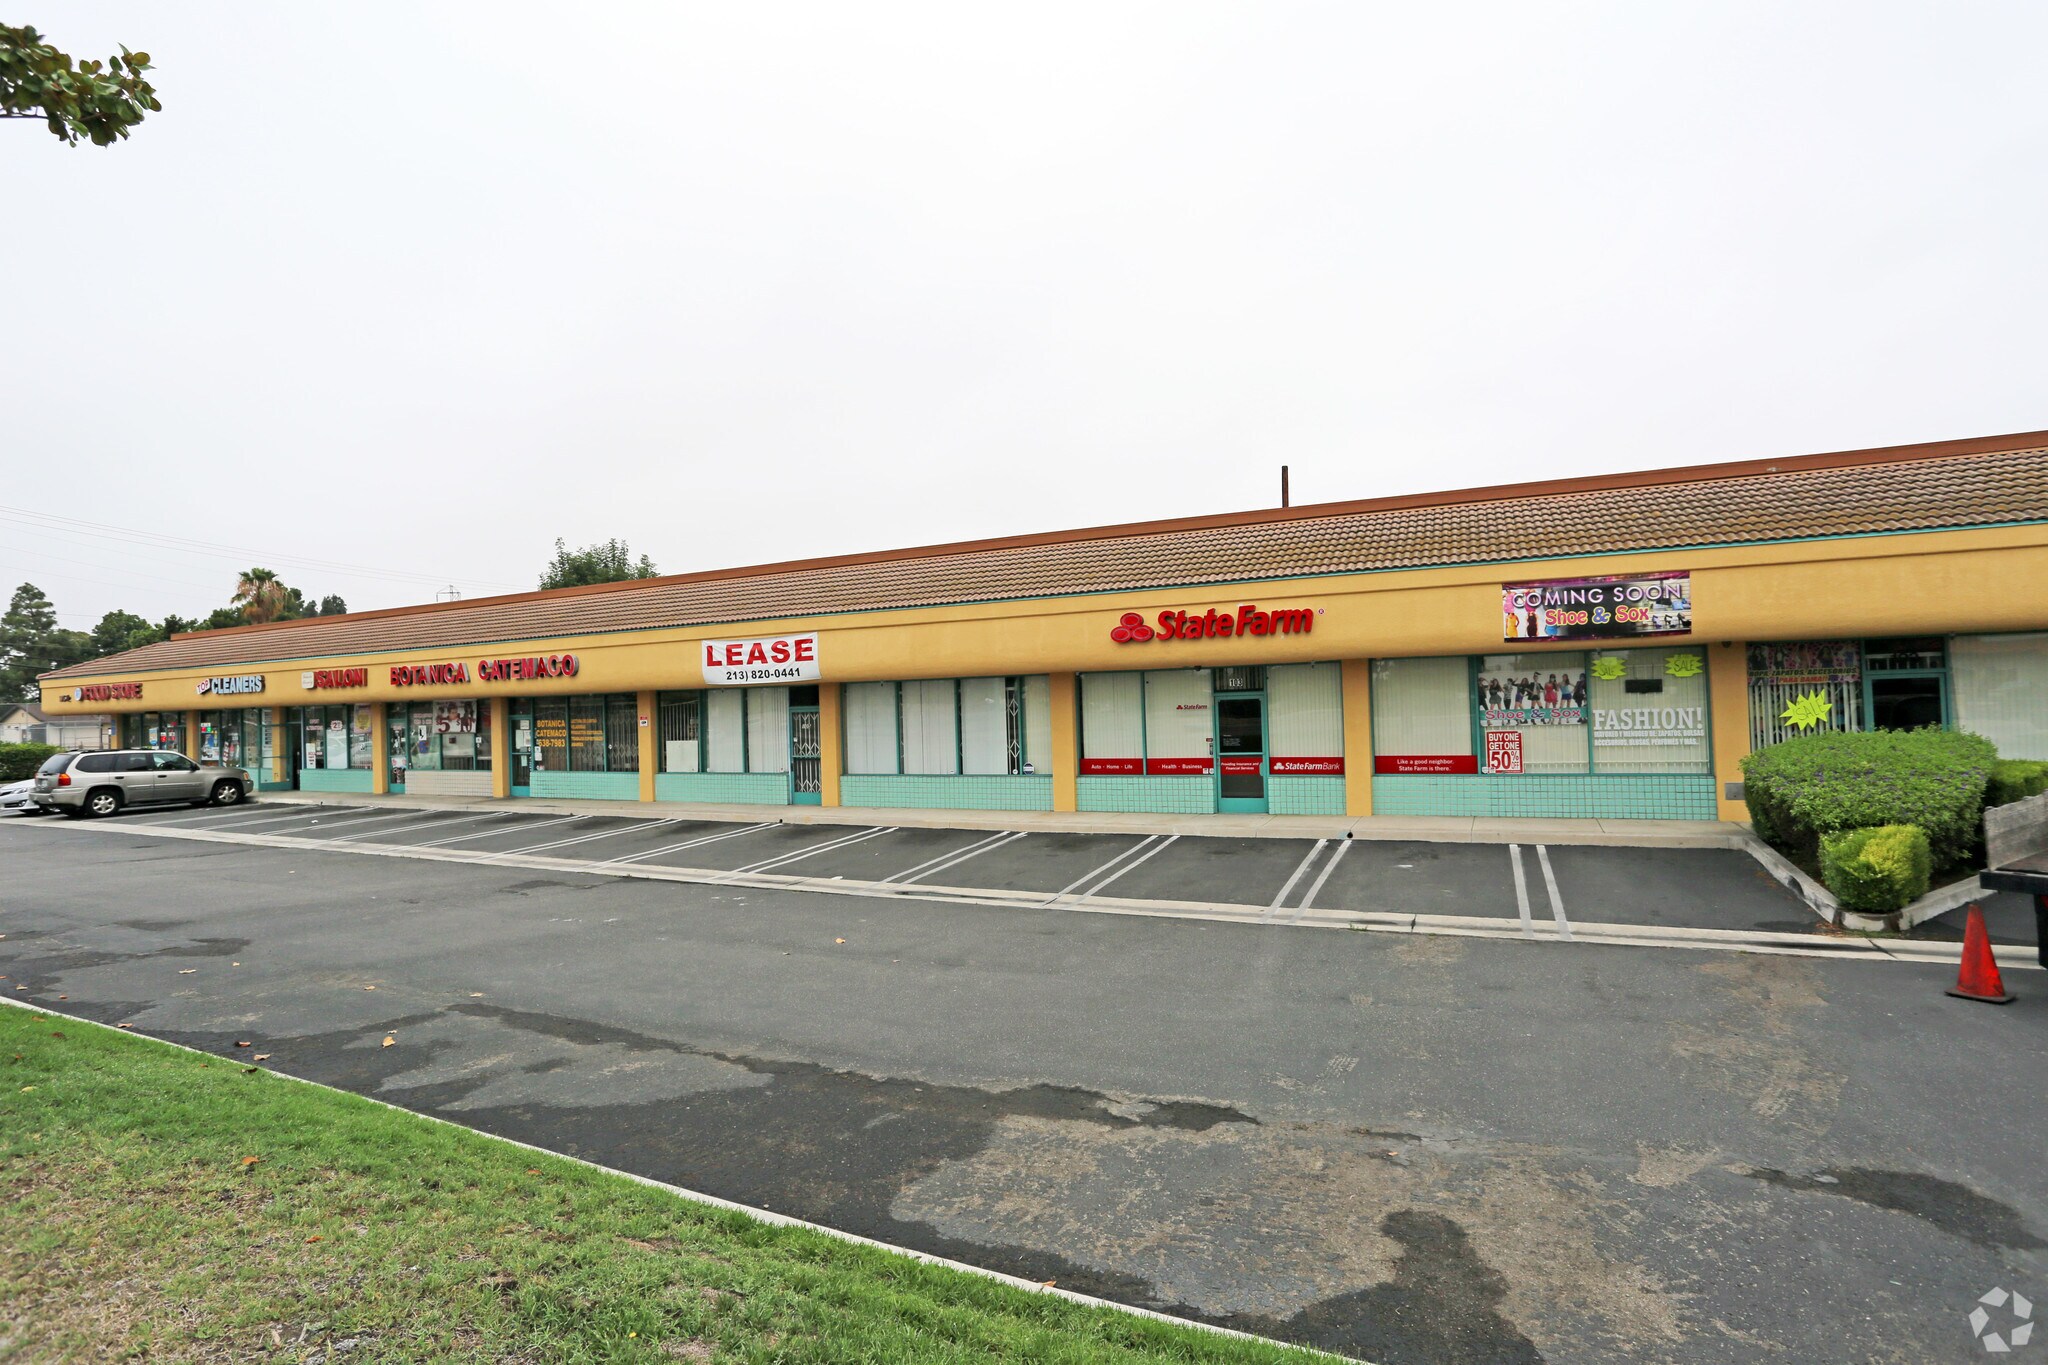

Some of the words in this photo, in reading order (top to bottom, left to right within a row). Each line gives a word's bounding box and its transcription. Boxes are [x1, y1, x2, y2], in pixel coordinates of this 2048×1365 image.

[1512, 588, 1604, 608] COMING
[1613, 584, 1682, 602] SOON
[1545, 609, 1588, 627] Shoe
[1592, 607, 1611, 624] &
[1615, 605, 1650, 622] Sox
[706, 638, 814, 667] LEASE
[390, 662, 468, 687] BOTANICA
[478, 653, 577, 681] CATEMACO
[751, 668, 801, 680] 820-0441
[1673, 659, 1695, 672] SALE
[197, 678, 210, 694] TOP
[211, 675, 263, 695] CLEANERS
[315, 668, 366, 689] SALON
[1485, 709, 1525, 720] Shoe
[1531, 708, 1544, 719] &
[1551, 708, 1581, 718] Sox
[1592, 707, 1703, 730] FASHION!
[1795, 699, 1826, 721] SALE
[537, 720, 566, 728] BOTANICA
[1488, 733, 1503, 741] BUY
[1504, 732, 1520, 741] ONE
[1488, 741, 1503, 750] GET
[1504, 741, 1520, 750] ONE
